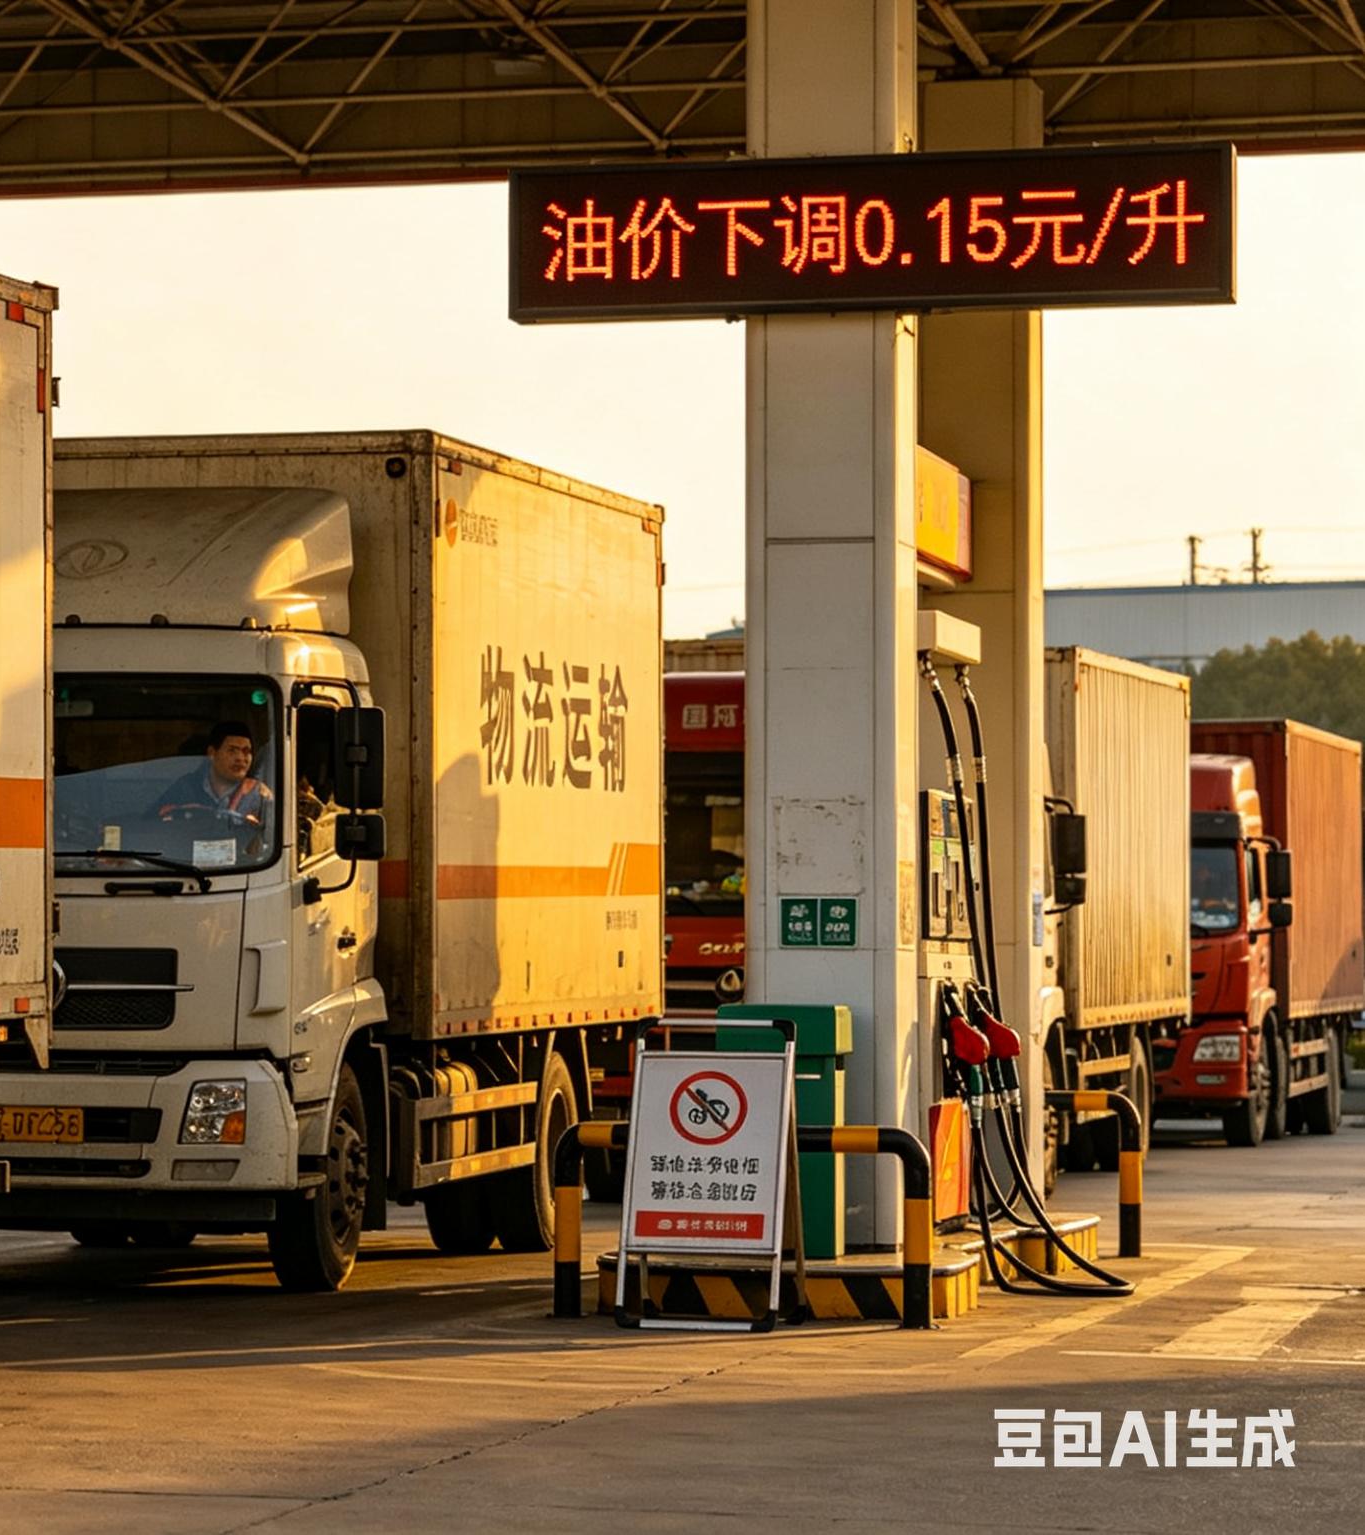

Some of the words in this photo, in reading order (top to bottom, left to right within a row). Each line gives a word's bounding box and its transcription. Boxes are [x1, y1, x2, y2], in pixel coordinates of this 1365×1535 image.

[542, 180, 1206, 283] 油价下调0.15元/升
[479, 643, 629, 794] 物流运输
